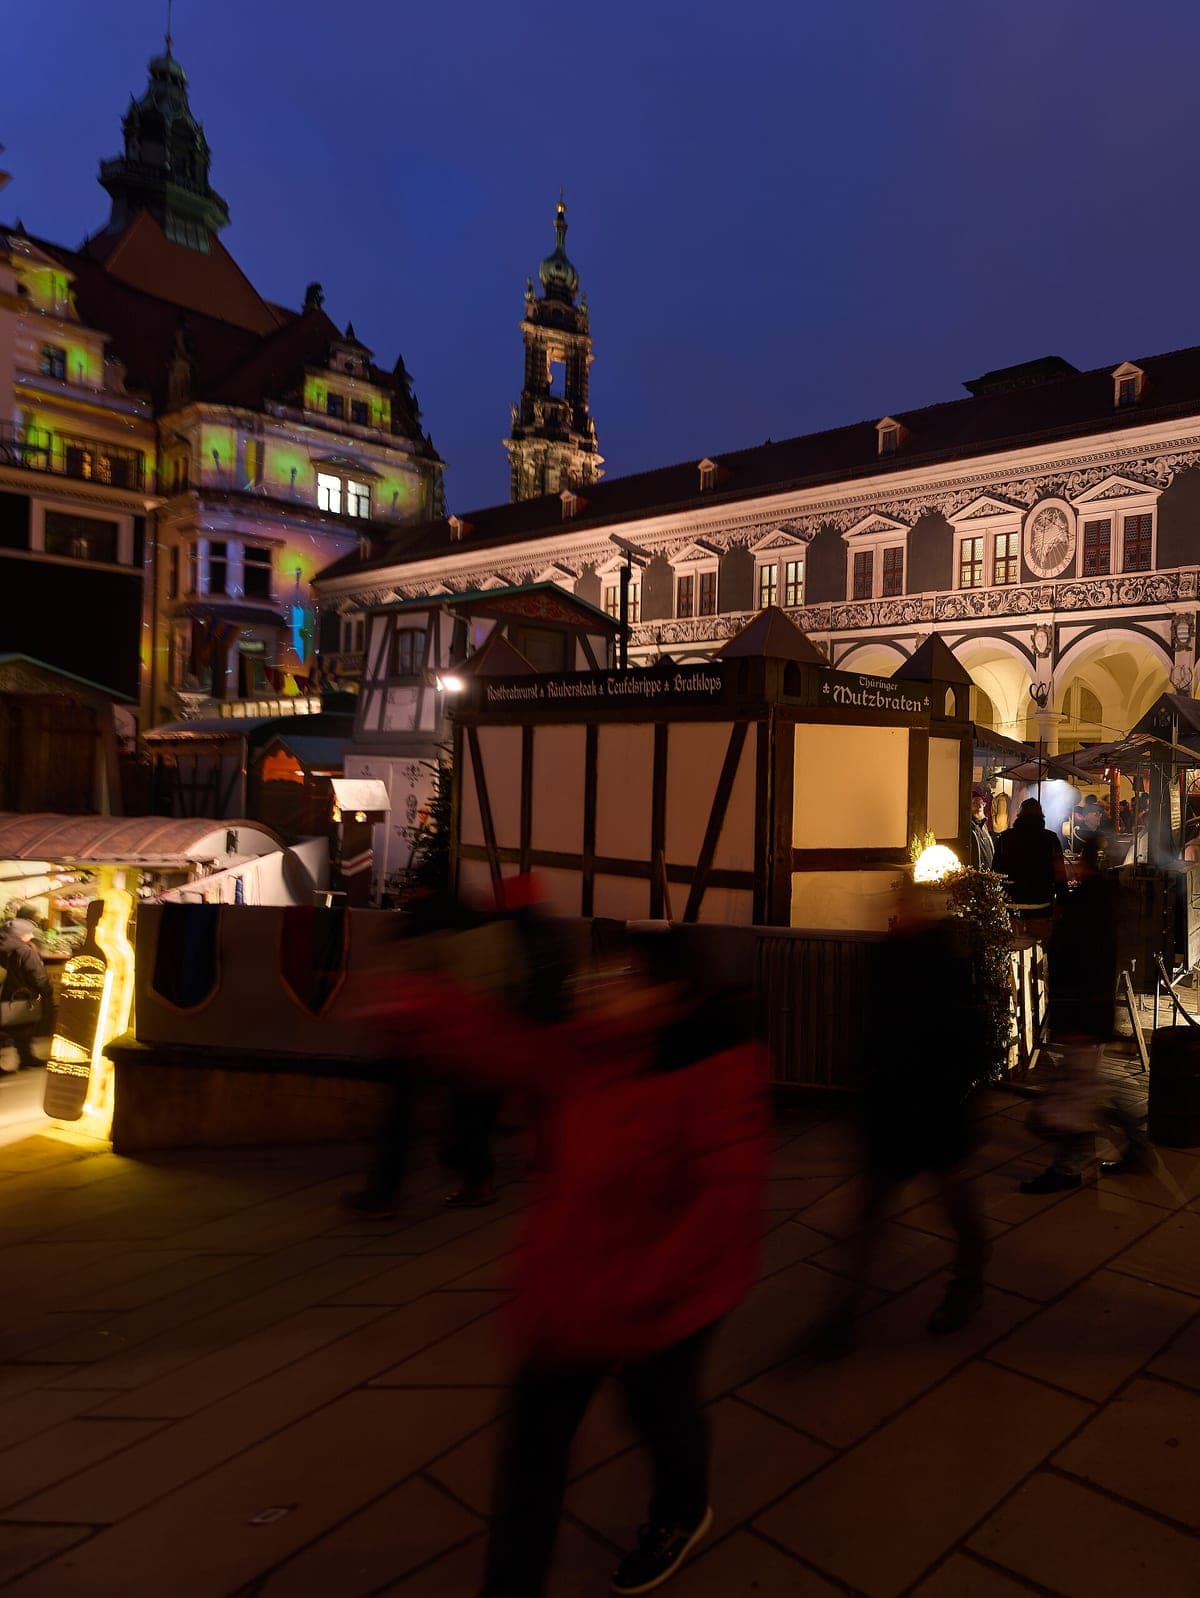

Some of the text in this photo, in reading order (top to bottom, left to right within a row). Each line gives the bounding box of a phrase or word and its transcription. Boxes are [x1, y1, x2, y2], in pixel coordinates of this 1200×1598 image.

[547, 680, 597, 698] Räubersteak
[607, 675, 662, 697] Teufelsrippe
[673, 672, 722, 696] Bratklops
[858, 676, 899, 692] Thüringer
[833, 684, 922, 712] Mutzbraten
